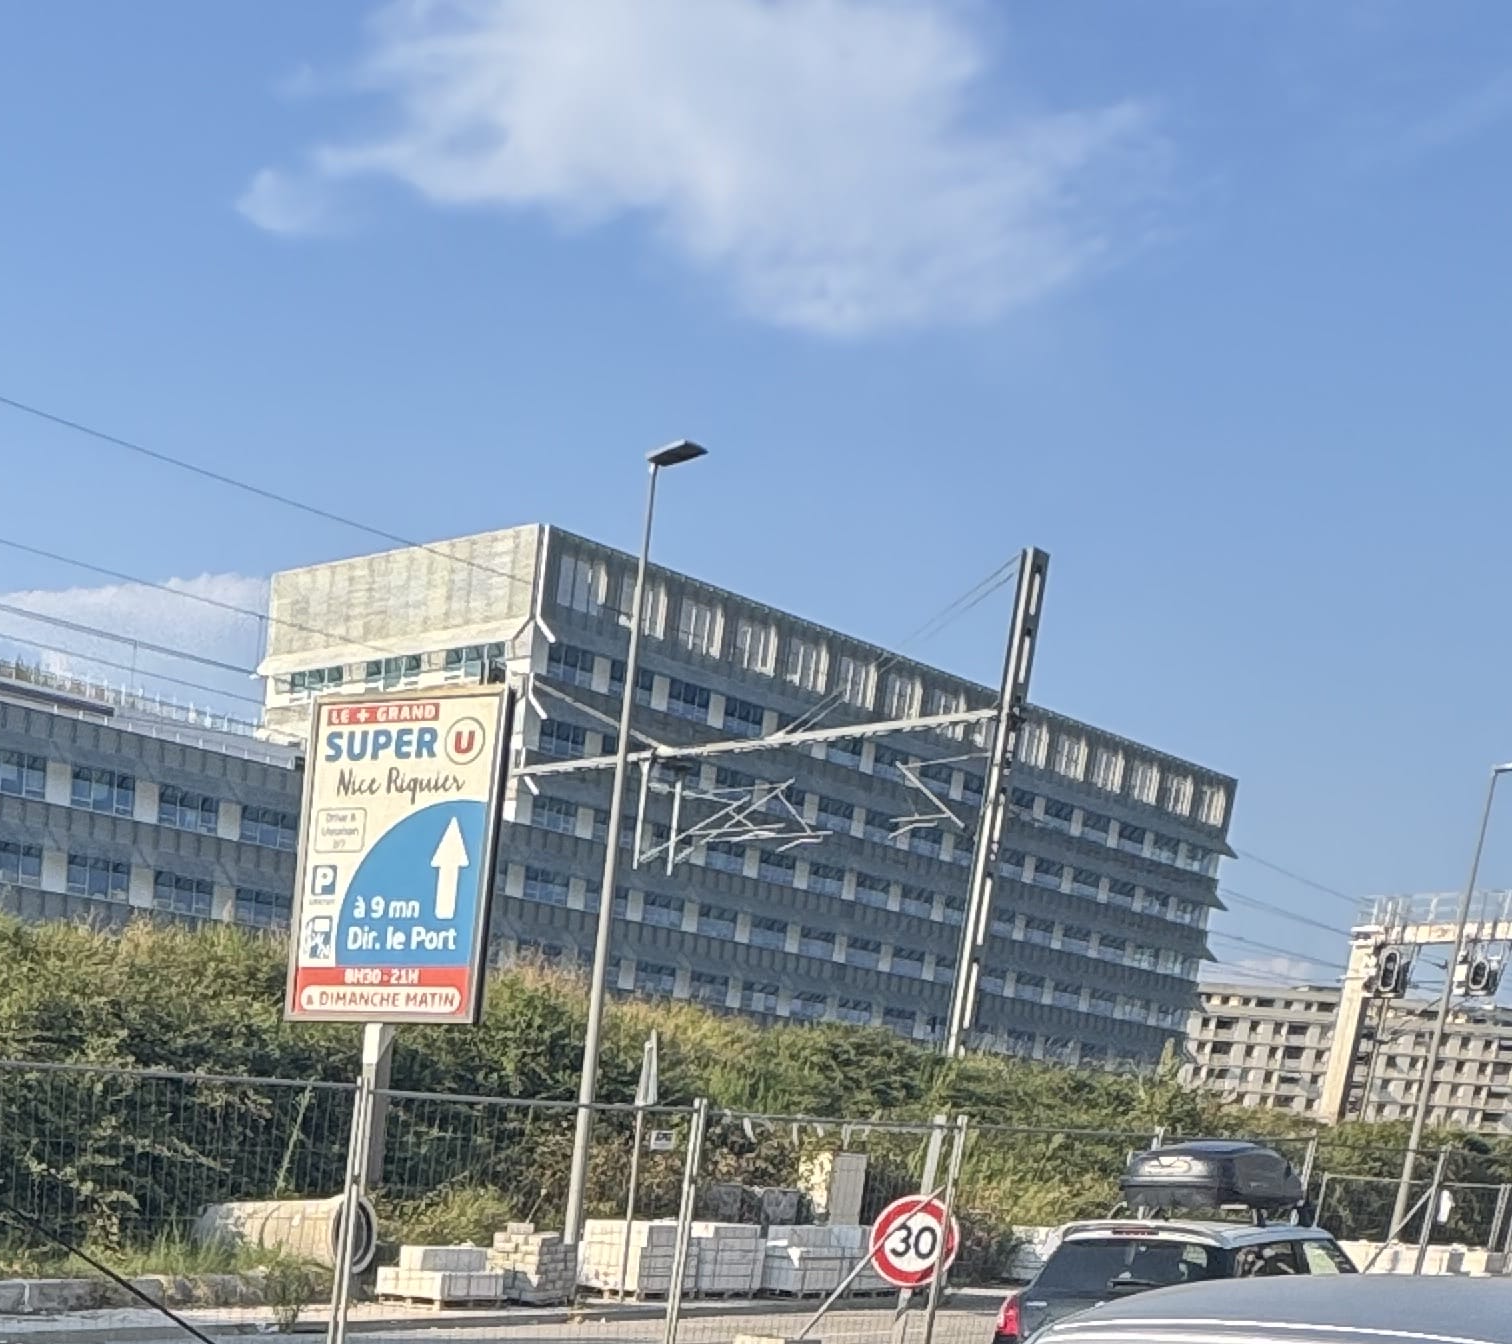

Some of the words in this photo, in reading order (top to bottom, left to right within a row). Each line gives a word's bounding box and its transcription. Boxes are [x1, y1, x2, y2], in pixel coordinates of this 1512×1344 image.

[331, 708, 349, 724] LE
[376, 704, 436, 720] GRAND
[324, 727, 438, 762] SUPER
[454, 730, 475, 754] U
[337, 767, 381, 797] Nice
[386, 766, 465, 805] Riquier
[353, 895, 365, 919] à
[370, 896, 385, 919] 9
[388, 900, 420, 918] mn
[347, 926, 380, 950] Dir.
[386, 926, 406, 950] le
[410, 926, 457, 950] Port
[319, 991, 401, 1007] DIMANCHE
[405, 992, 456, 1007] MATIN
[889, 1225, 937, 1260] 30
